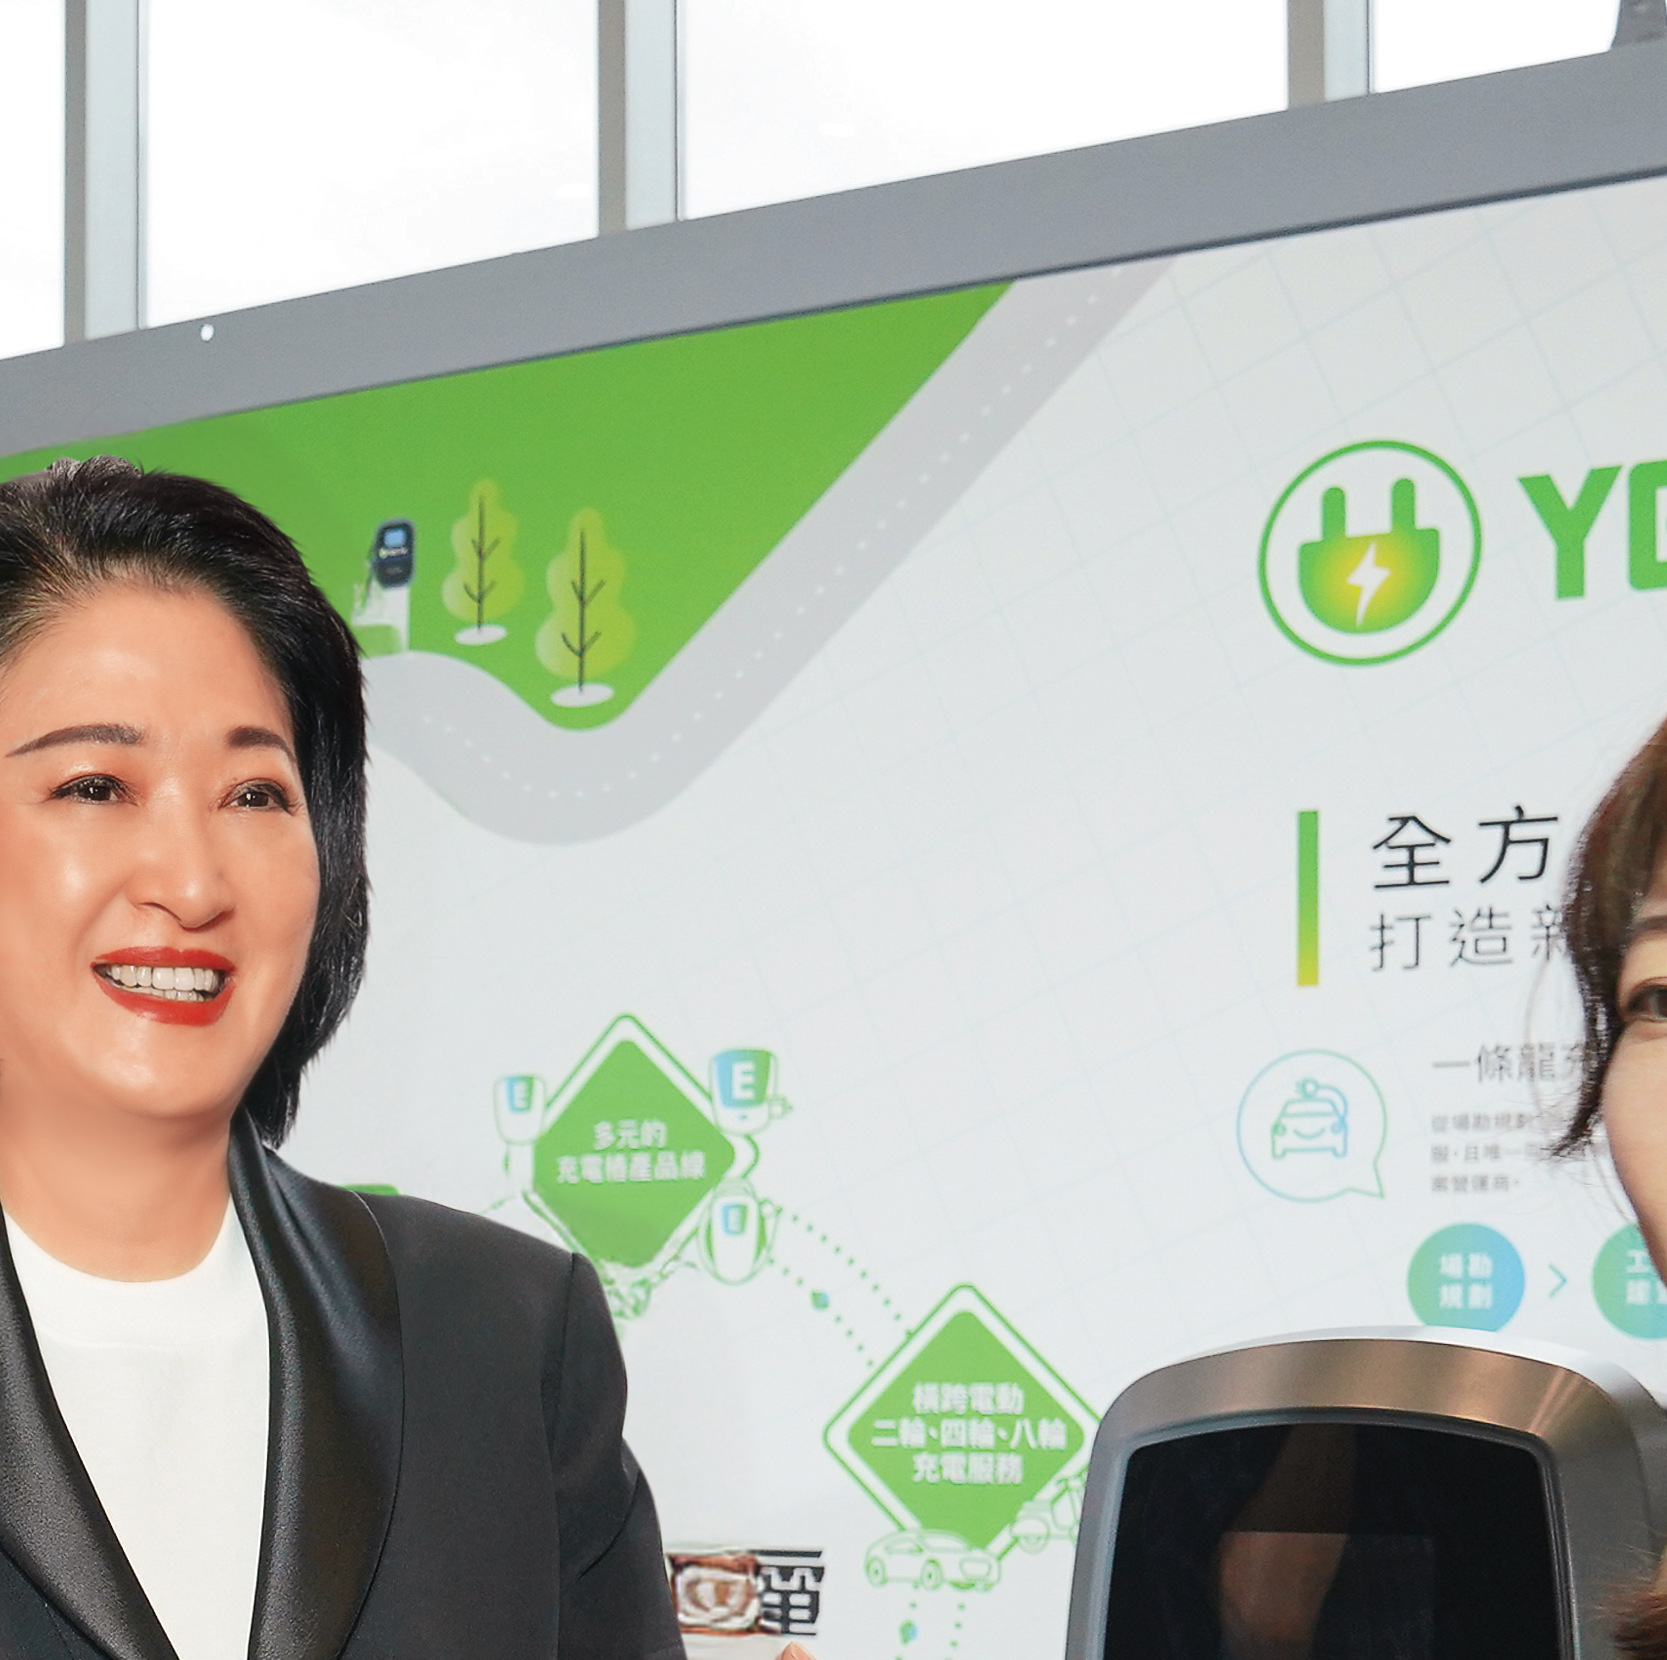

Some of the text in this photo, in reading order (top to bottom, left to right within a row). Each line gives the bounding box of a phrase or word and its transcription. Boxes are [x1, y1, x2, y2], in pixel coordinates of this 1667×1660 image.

[1373, 805, 1558, 889] 全方
[593, 1118, 666, 1151] 多元的
